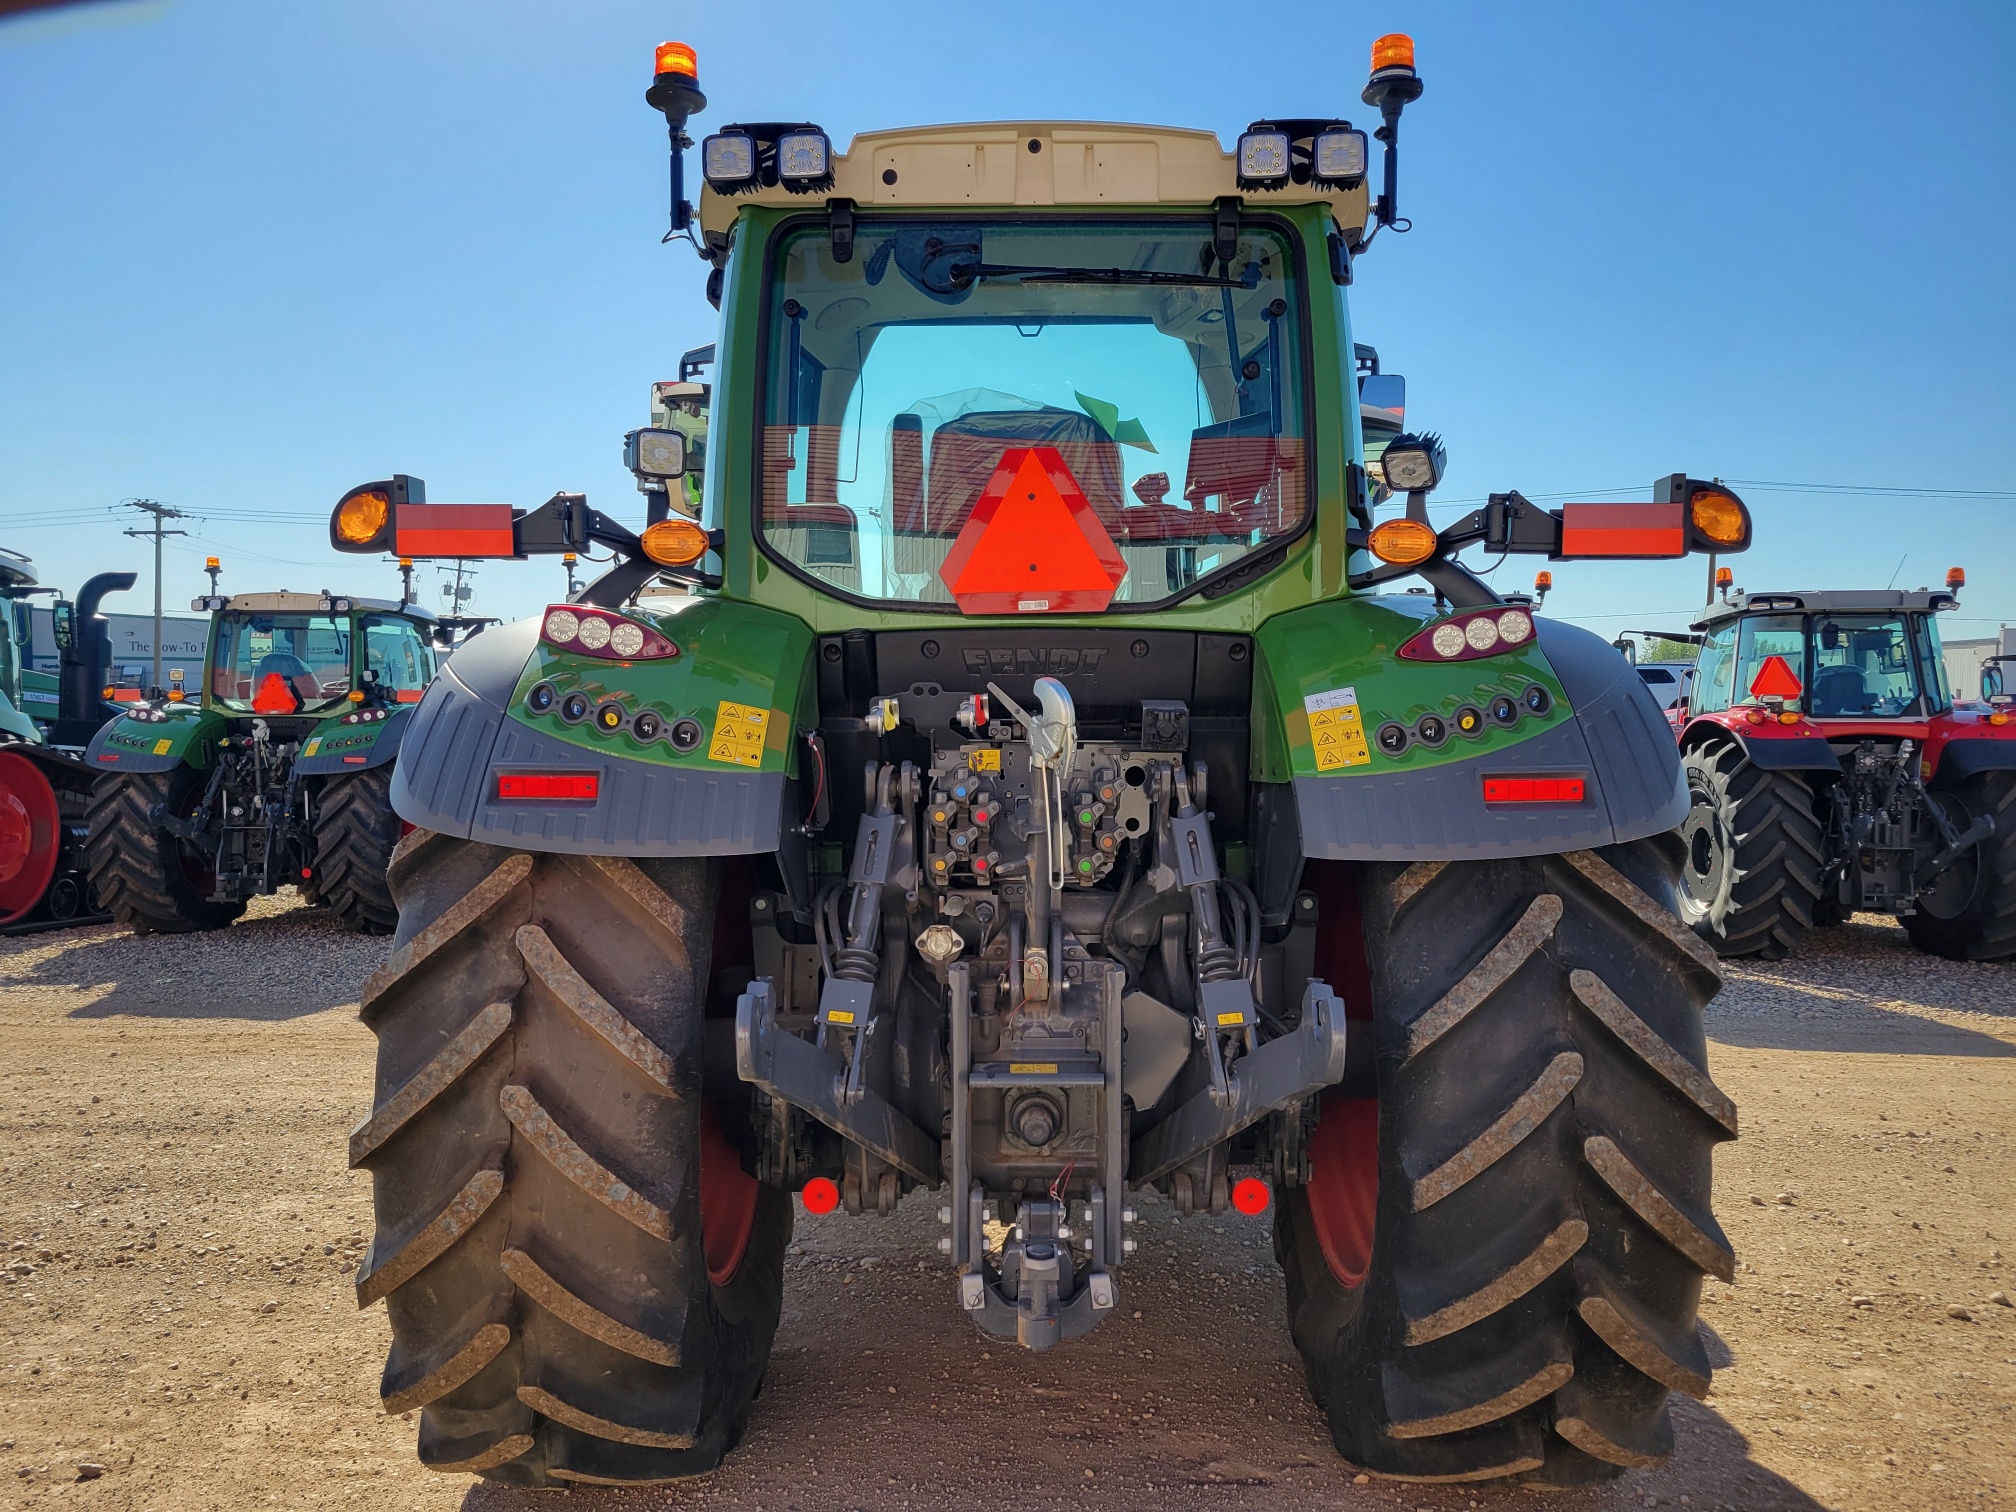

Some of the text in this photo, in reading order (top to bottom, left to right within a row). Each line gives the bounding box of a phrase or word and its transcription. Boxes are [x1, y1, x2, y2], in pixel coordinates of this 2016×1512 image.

[129, 641, 150, 653] The
[153, 641, 197, 653] ow-To
[961, 648, 1110, 676] FENDT
